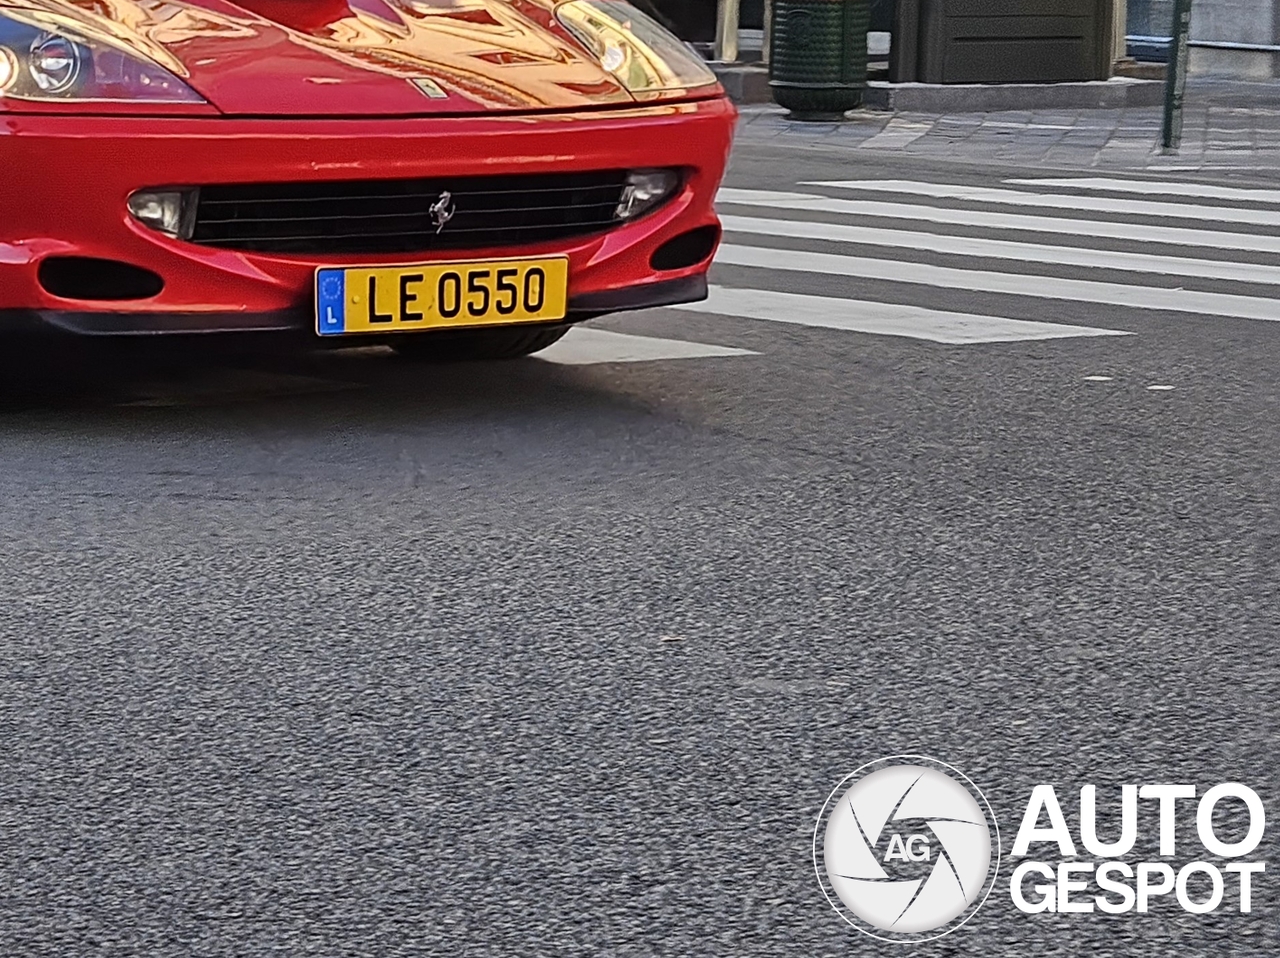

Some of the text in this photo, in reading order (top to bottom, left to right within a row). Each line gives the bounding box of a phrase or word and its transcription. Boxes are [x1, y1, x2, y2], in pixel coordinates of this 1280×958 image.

[368, 267, 546, 324] LE 0550
[326, 306, 338, 324] L
